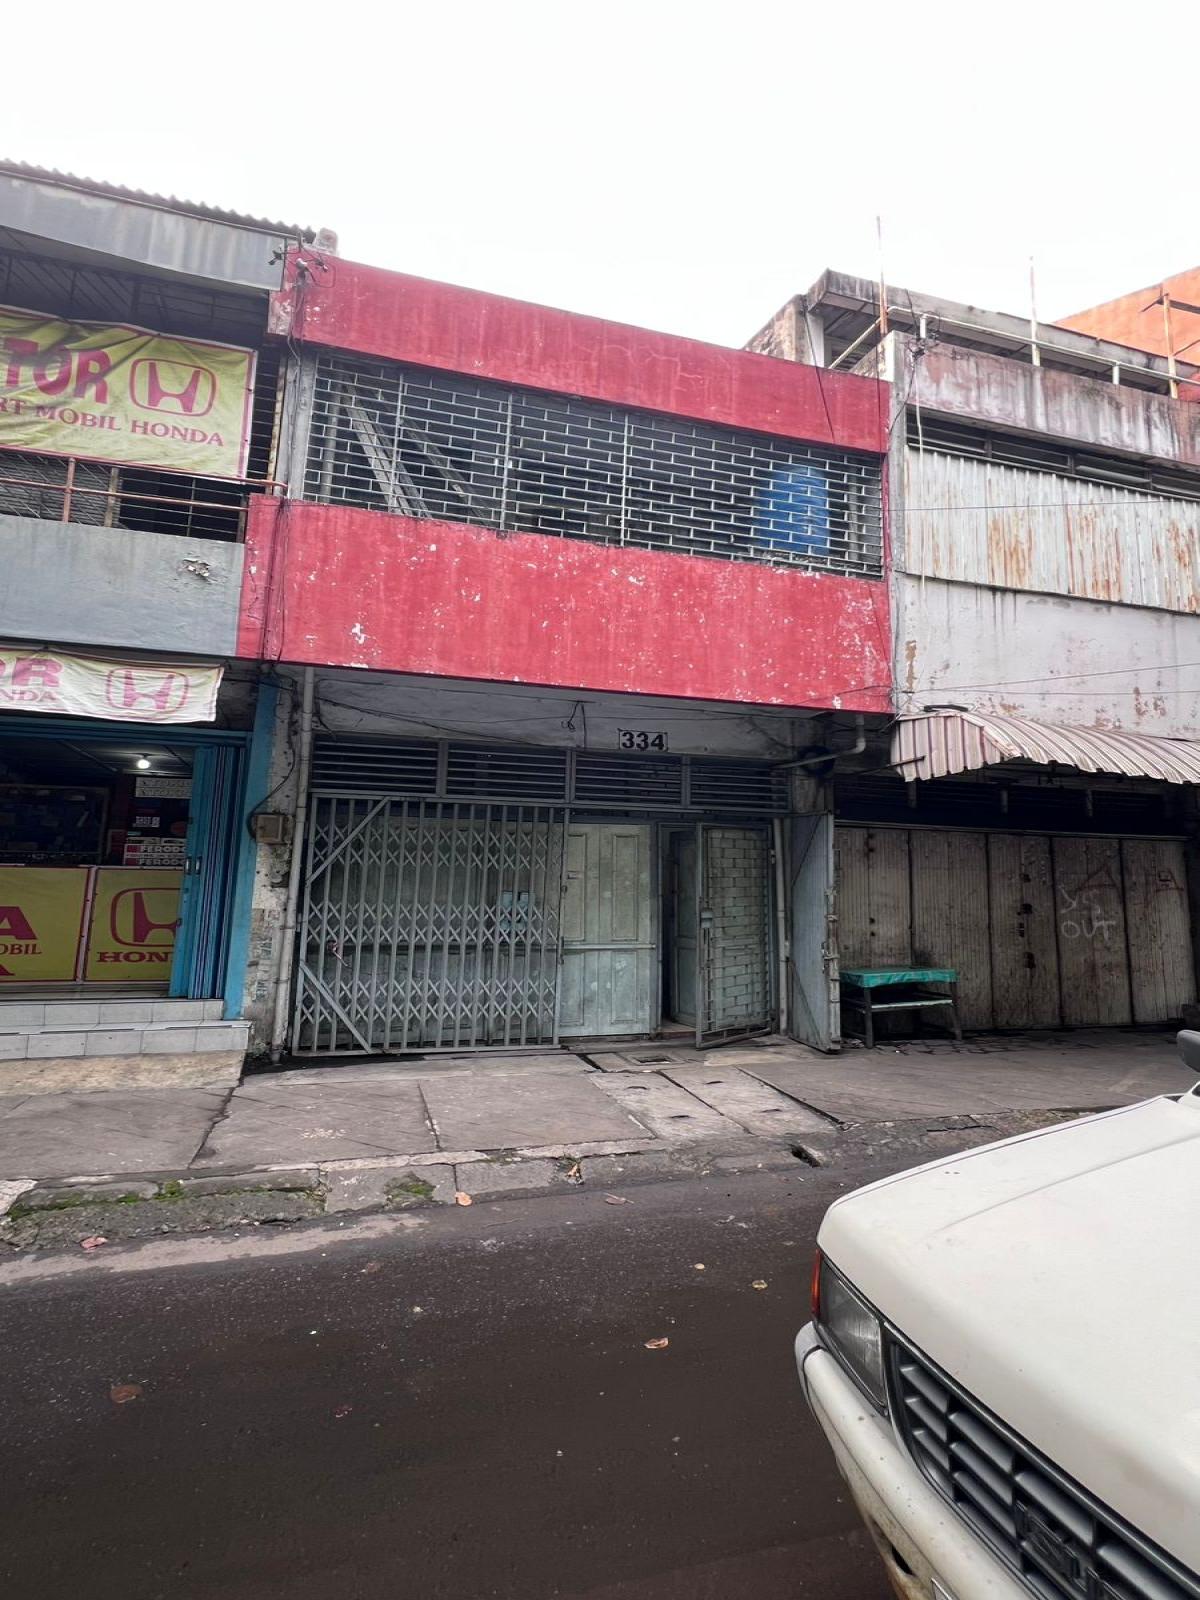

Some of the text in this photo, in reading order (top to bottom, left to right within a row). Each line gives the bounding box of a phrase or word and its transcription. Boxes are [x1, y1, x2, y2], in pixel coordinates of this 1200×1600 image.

[35, 405, 121, 431] MOBIL
[131, 420, 224, 447] HONDA
[0, 657, 63, 688] R
[621, 731, 665, 751] 334
[1060, 919, 1116, 941] OUT
[96, 951, 174, 963] HON
